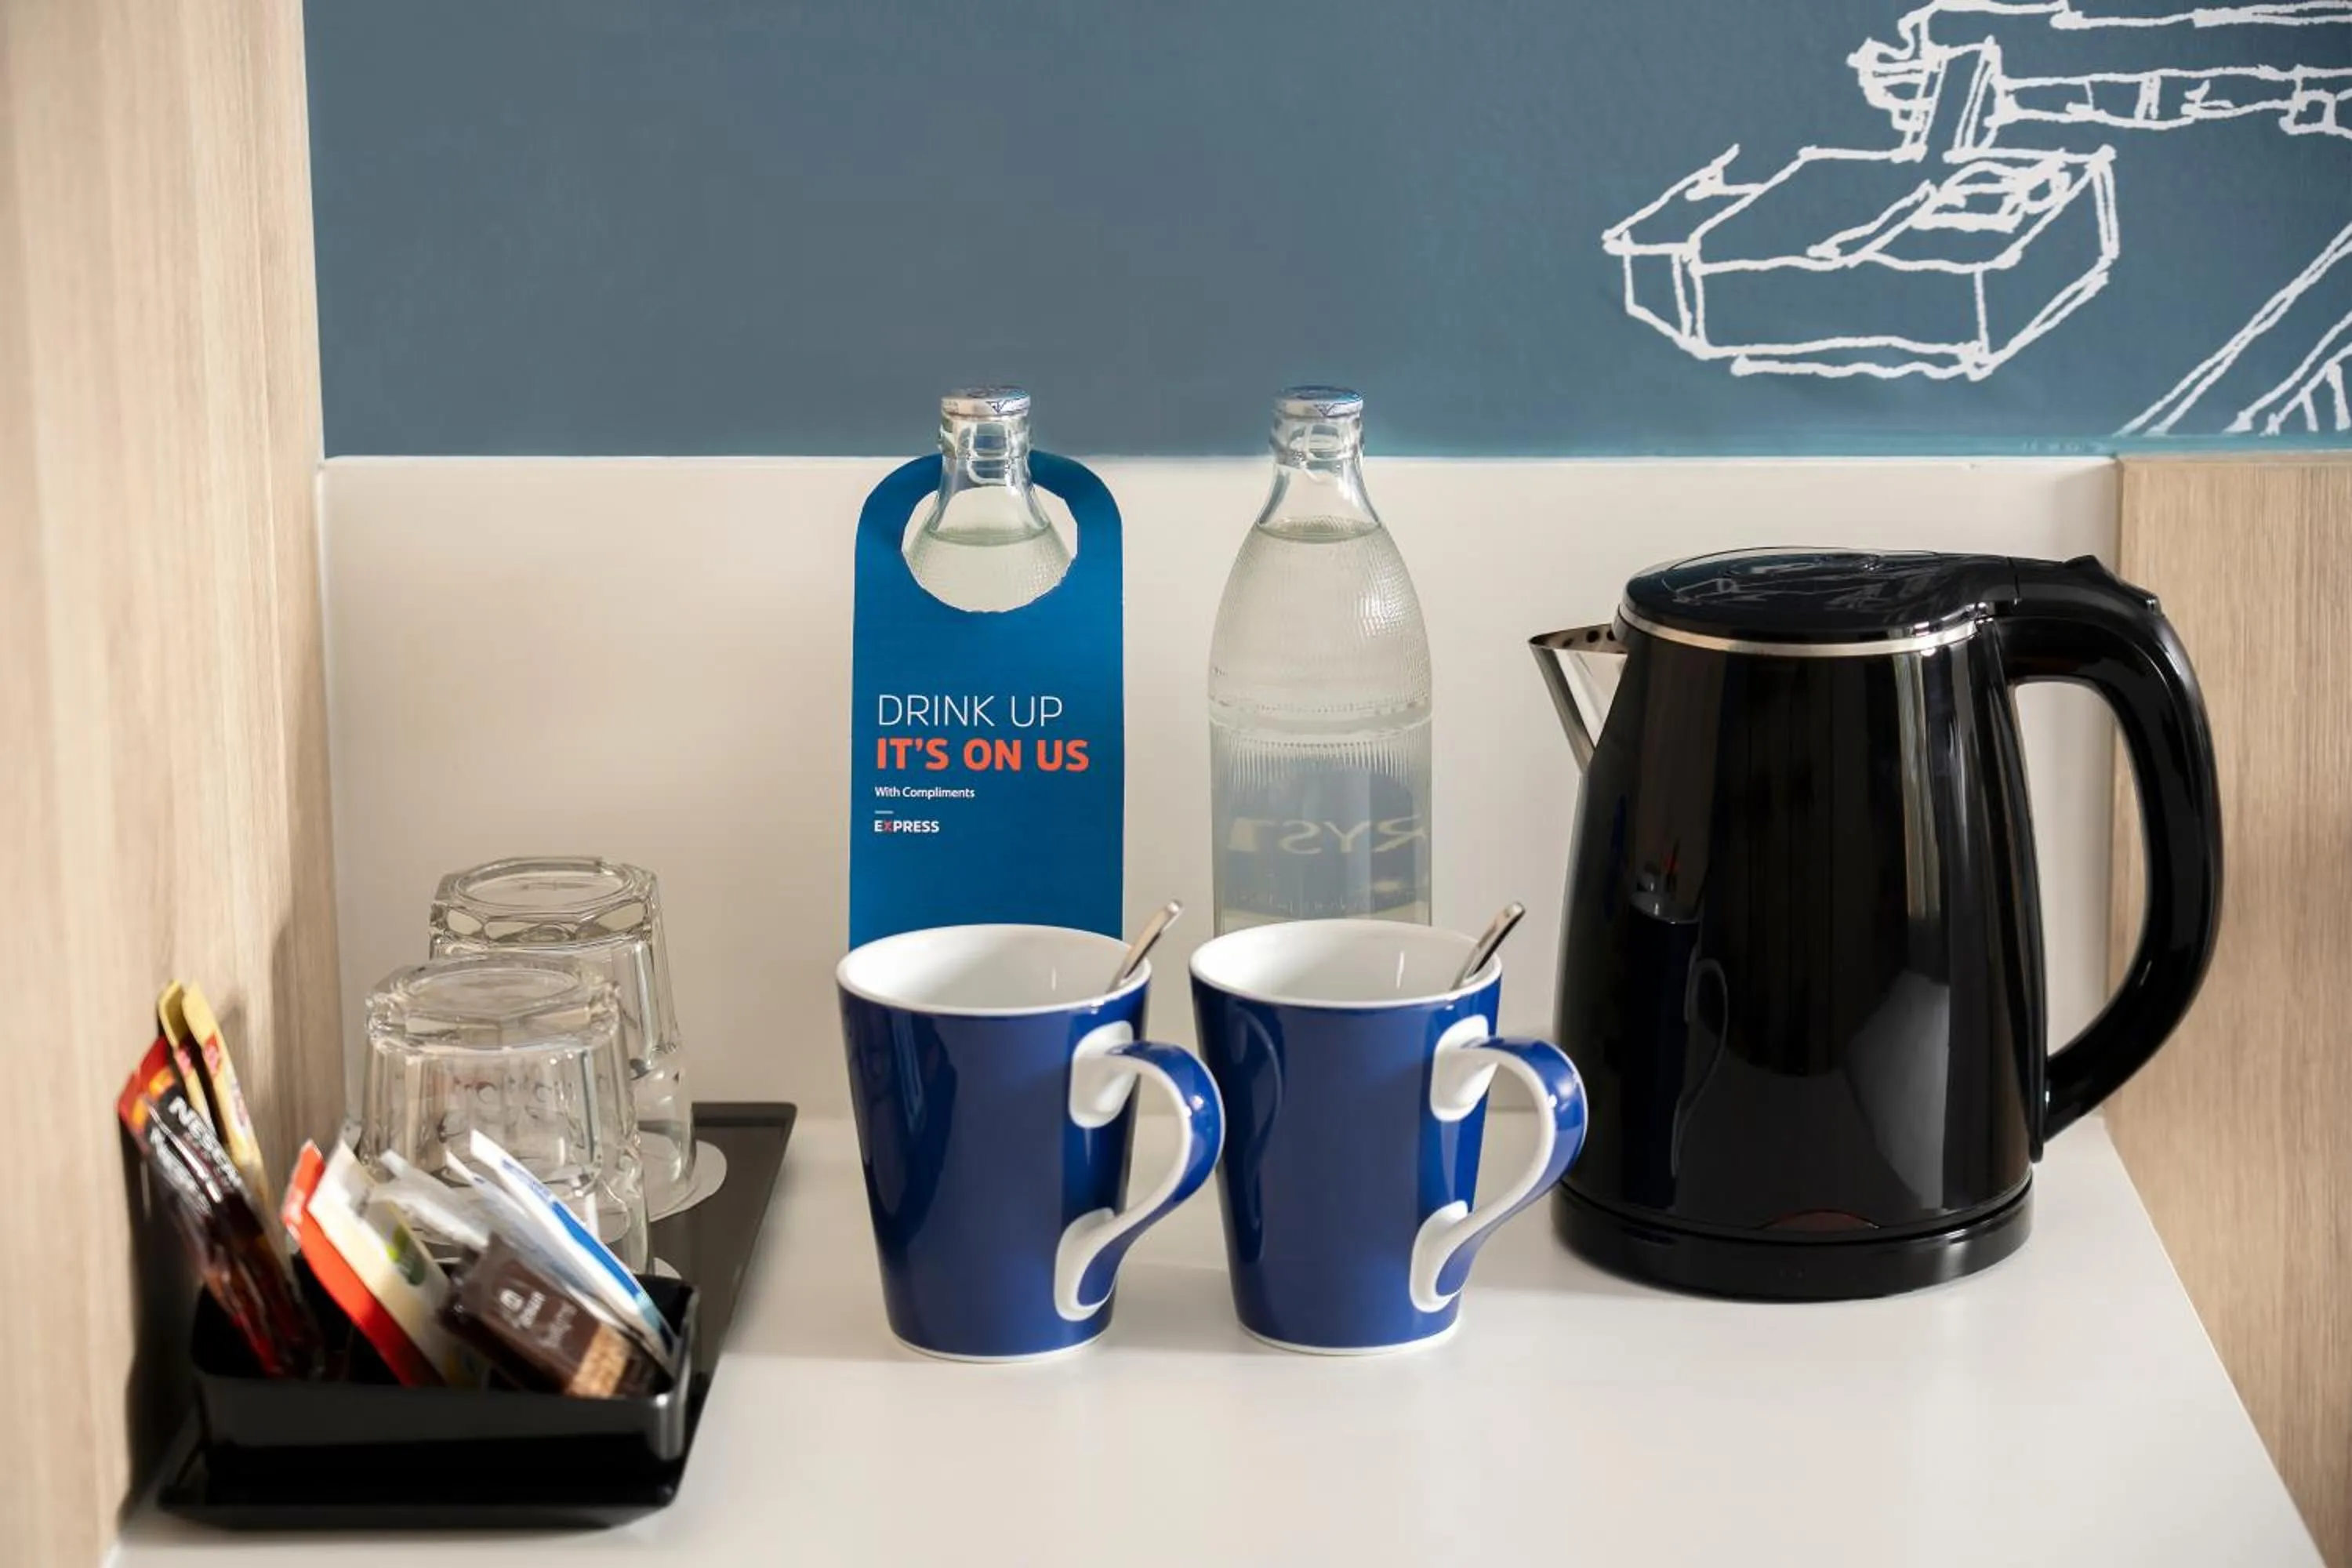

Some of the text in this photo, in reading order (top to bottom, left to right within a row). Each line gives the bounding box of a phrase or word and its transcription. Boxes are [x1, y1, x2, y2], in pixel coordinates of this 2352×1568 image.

[878, 694, 1063, 728] DRINK UP
[877, 738, 1090, 772] IT'S ON US
[874, 786, 976, 800] With Compliments
[874, 819, 940, 833] EXPRESS
